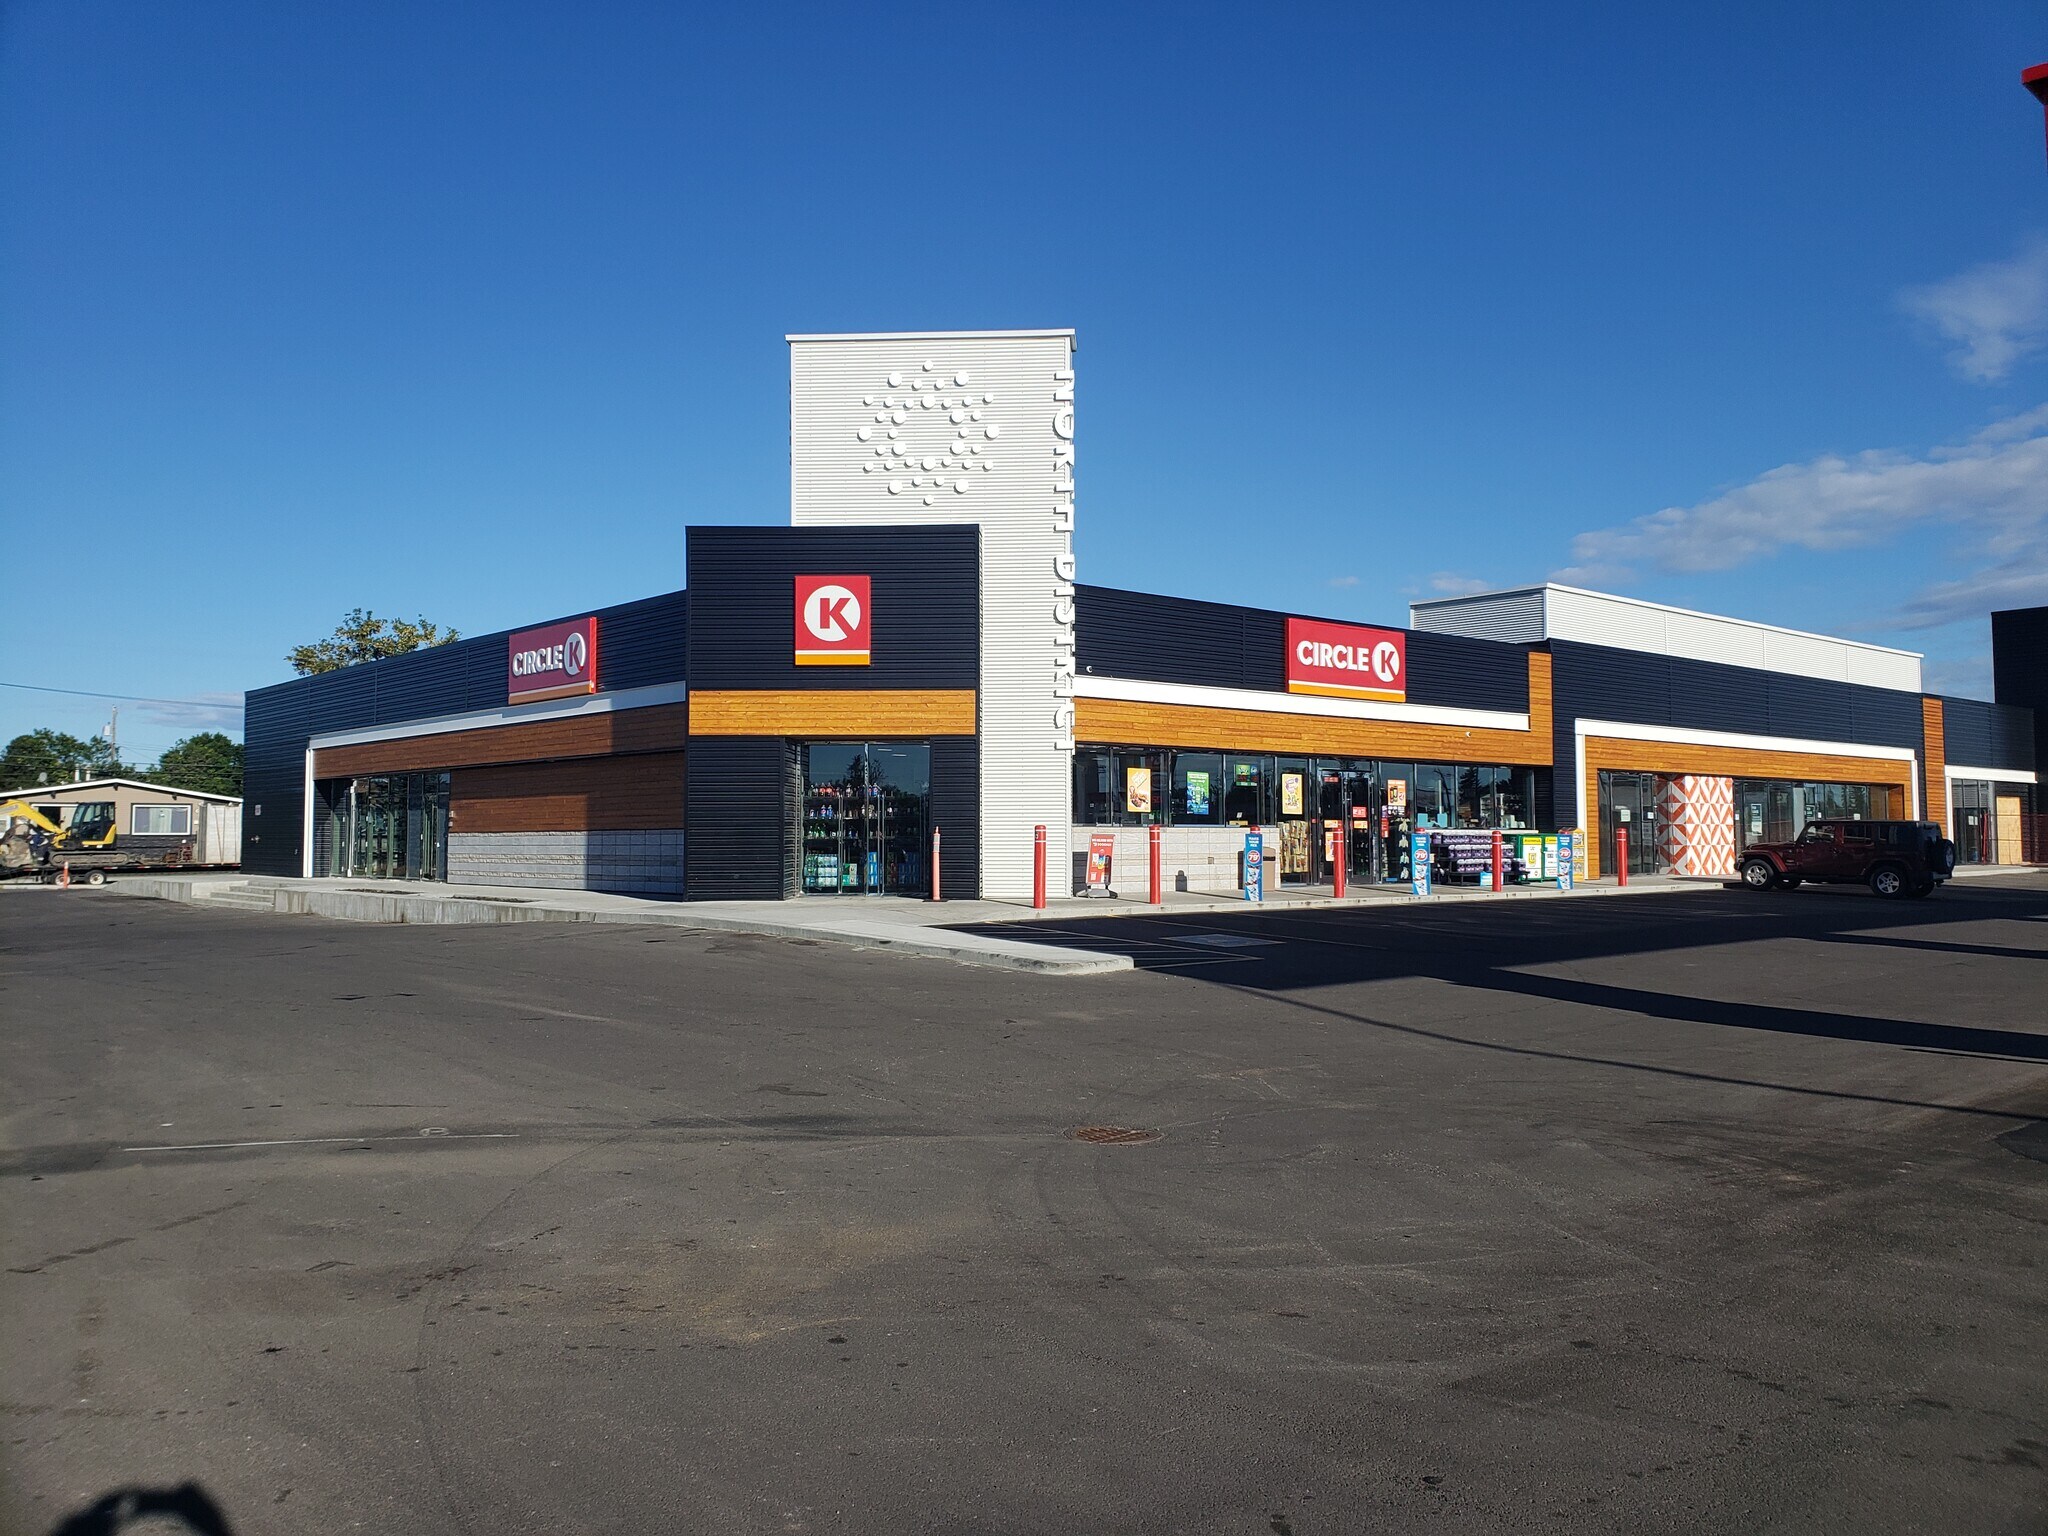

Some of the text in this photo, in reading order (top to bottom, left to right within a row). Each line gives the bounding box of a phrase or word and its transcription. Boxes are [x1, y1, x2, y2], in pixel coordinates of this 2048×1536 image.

[817, 595, 857, 639] K
[512, 644, 563, 677] CIRCLE
[1296, 640, 1370, 672] CIRCLE
